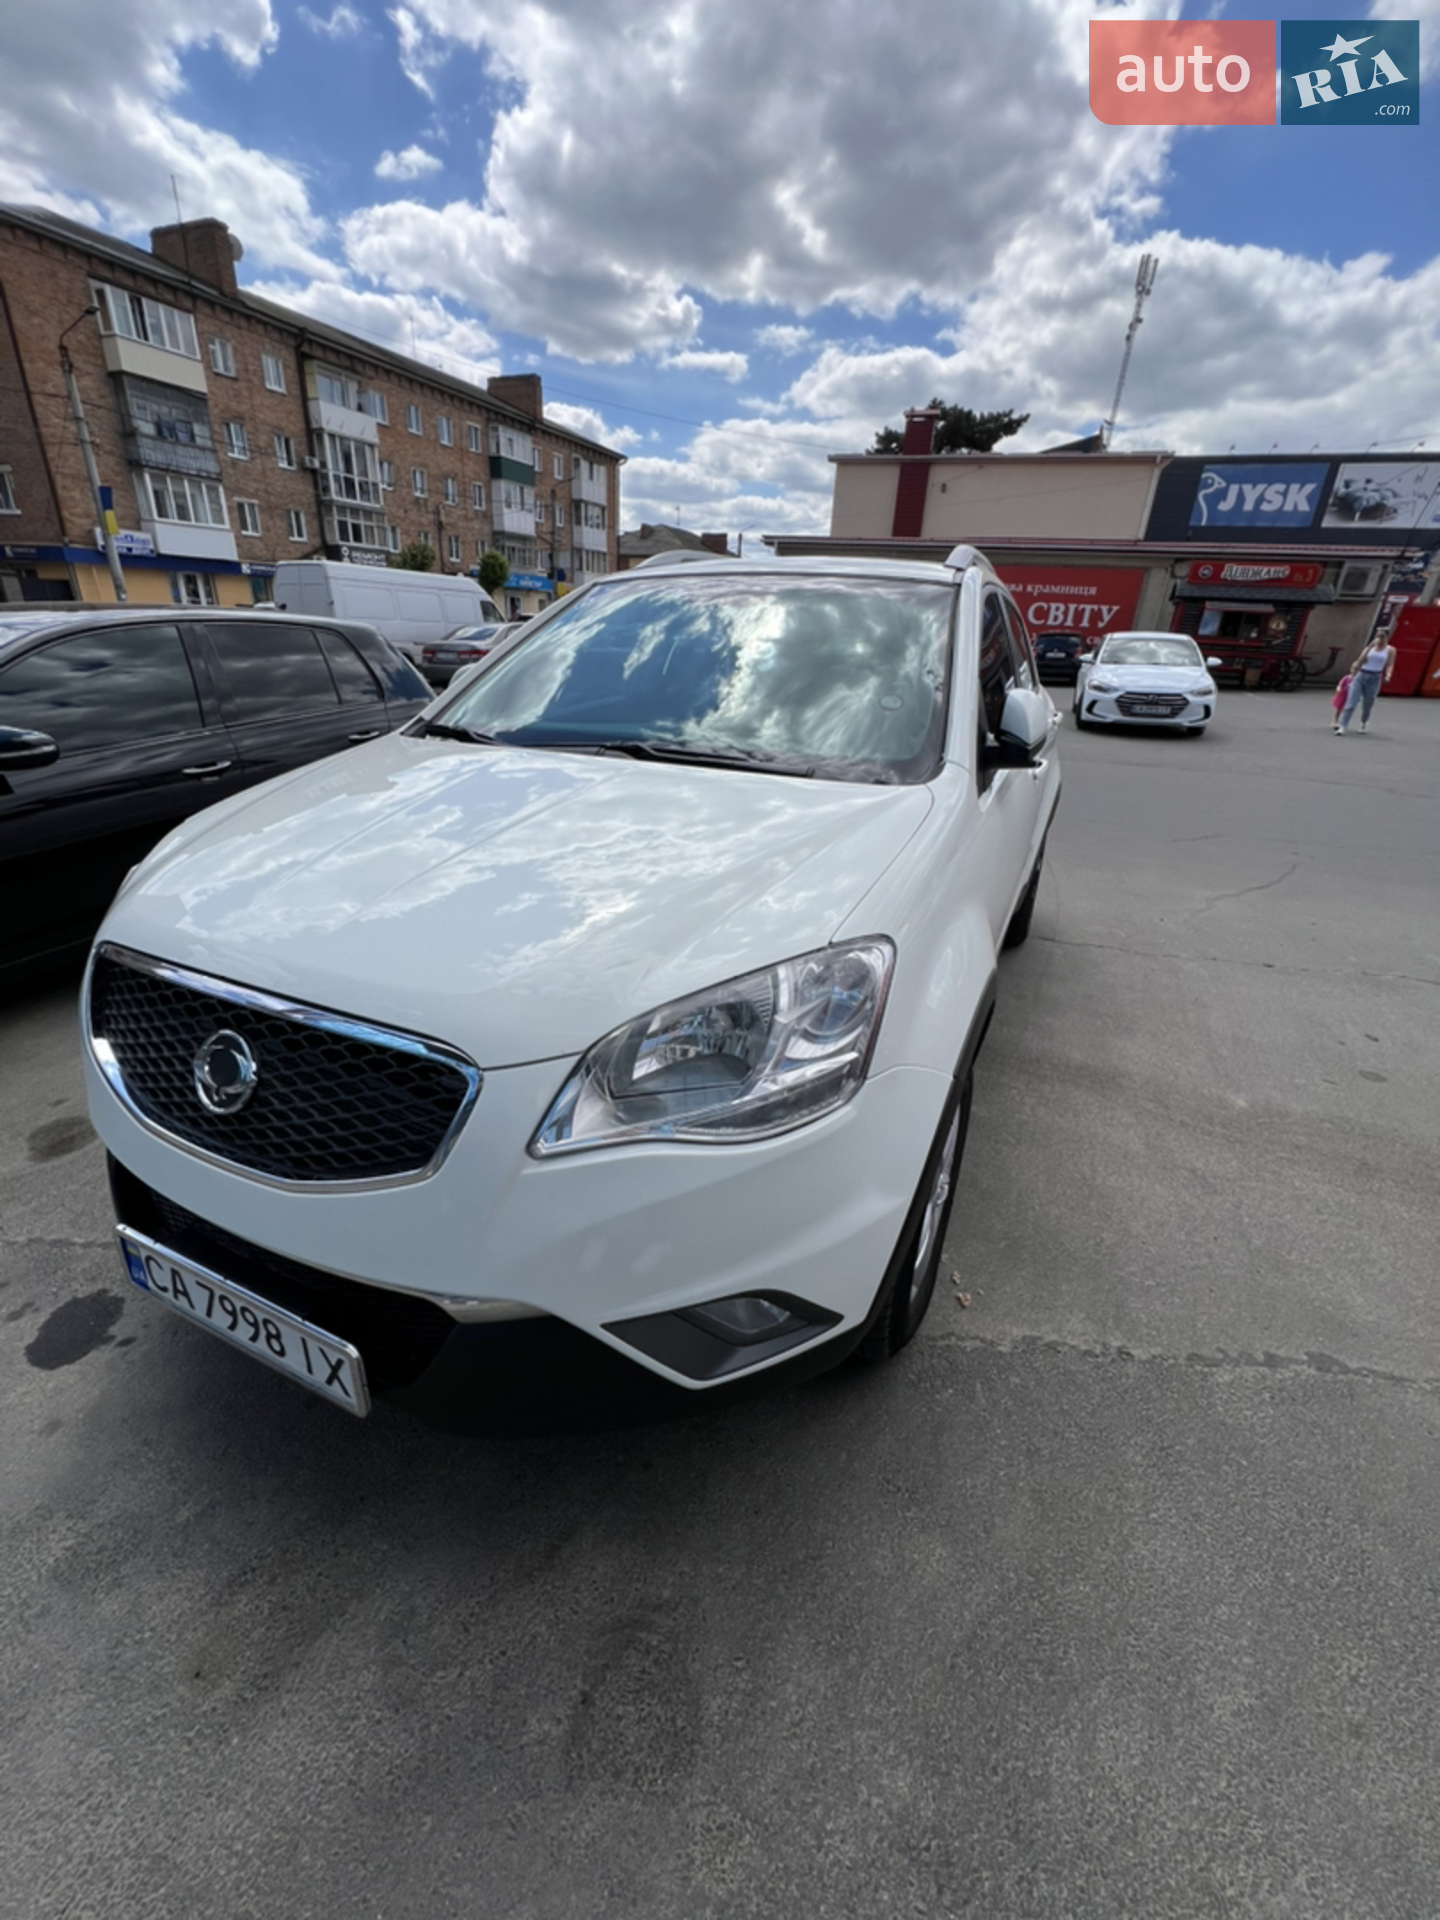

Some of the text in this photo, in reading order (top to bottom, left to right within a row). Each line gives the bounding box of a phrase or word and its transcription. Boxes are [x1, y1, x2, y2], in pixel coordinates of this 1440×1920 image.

[1217, 482, 1317, 512] JYSK
[1026, 583, 1098, 597] крамниця
[1027, 601, 1121, 628] СВІТУ
[145, 1254, 196, 1311] CA
[196, 1279, 287, 1358] 7998
[300, 1336, 352, 1399] IX
